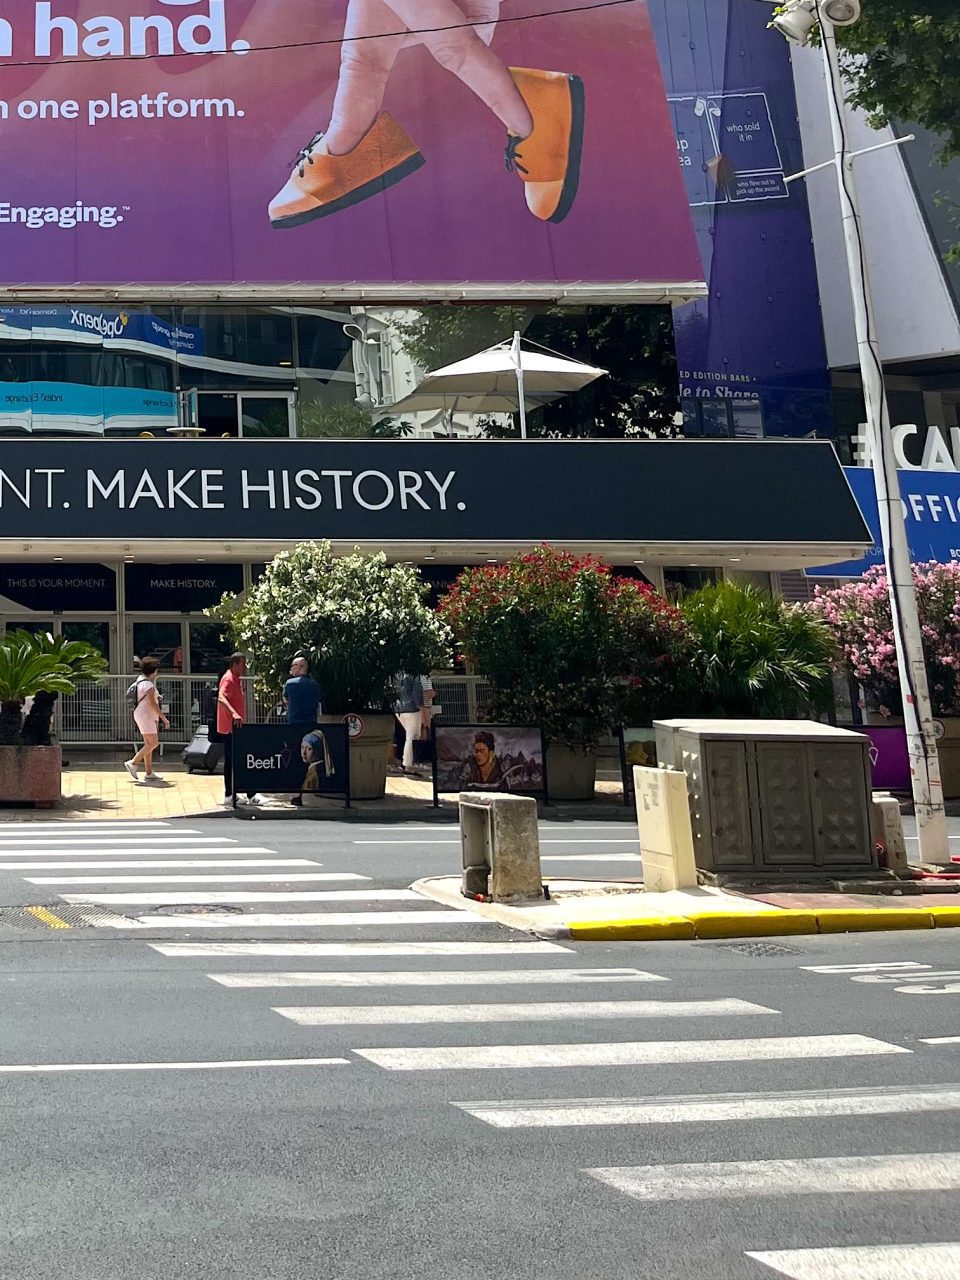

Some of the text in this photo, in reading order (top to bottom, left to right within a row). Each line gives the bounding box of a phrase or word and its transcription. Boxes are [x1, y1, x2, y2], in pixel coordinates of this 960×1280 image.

[34, 0, 251, 57] hand.
[17, 99, 79, 120] one
[88, 92, 245, 126] platform.
[726, 121, 760, 132] who sold
[693, 371, 727, 380] EDITION
[730, 374, 750, 382] BARS
[86, 469, 225, 509] MAKE
[241, 469, 467, 511] HISTORY.
[8, 579, 107, 588] THIS IS YOUR MOMENT.
[150, 579, 217, 588] MAKE HISTORY.
